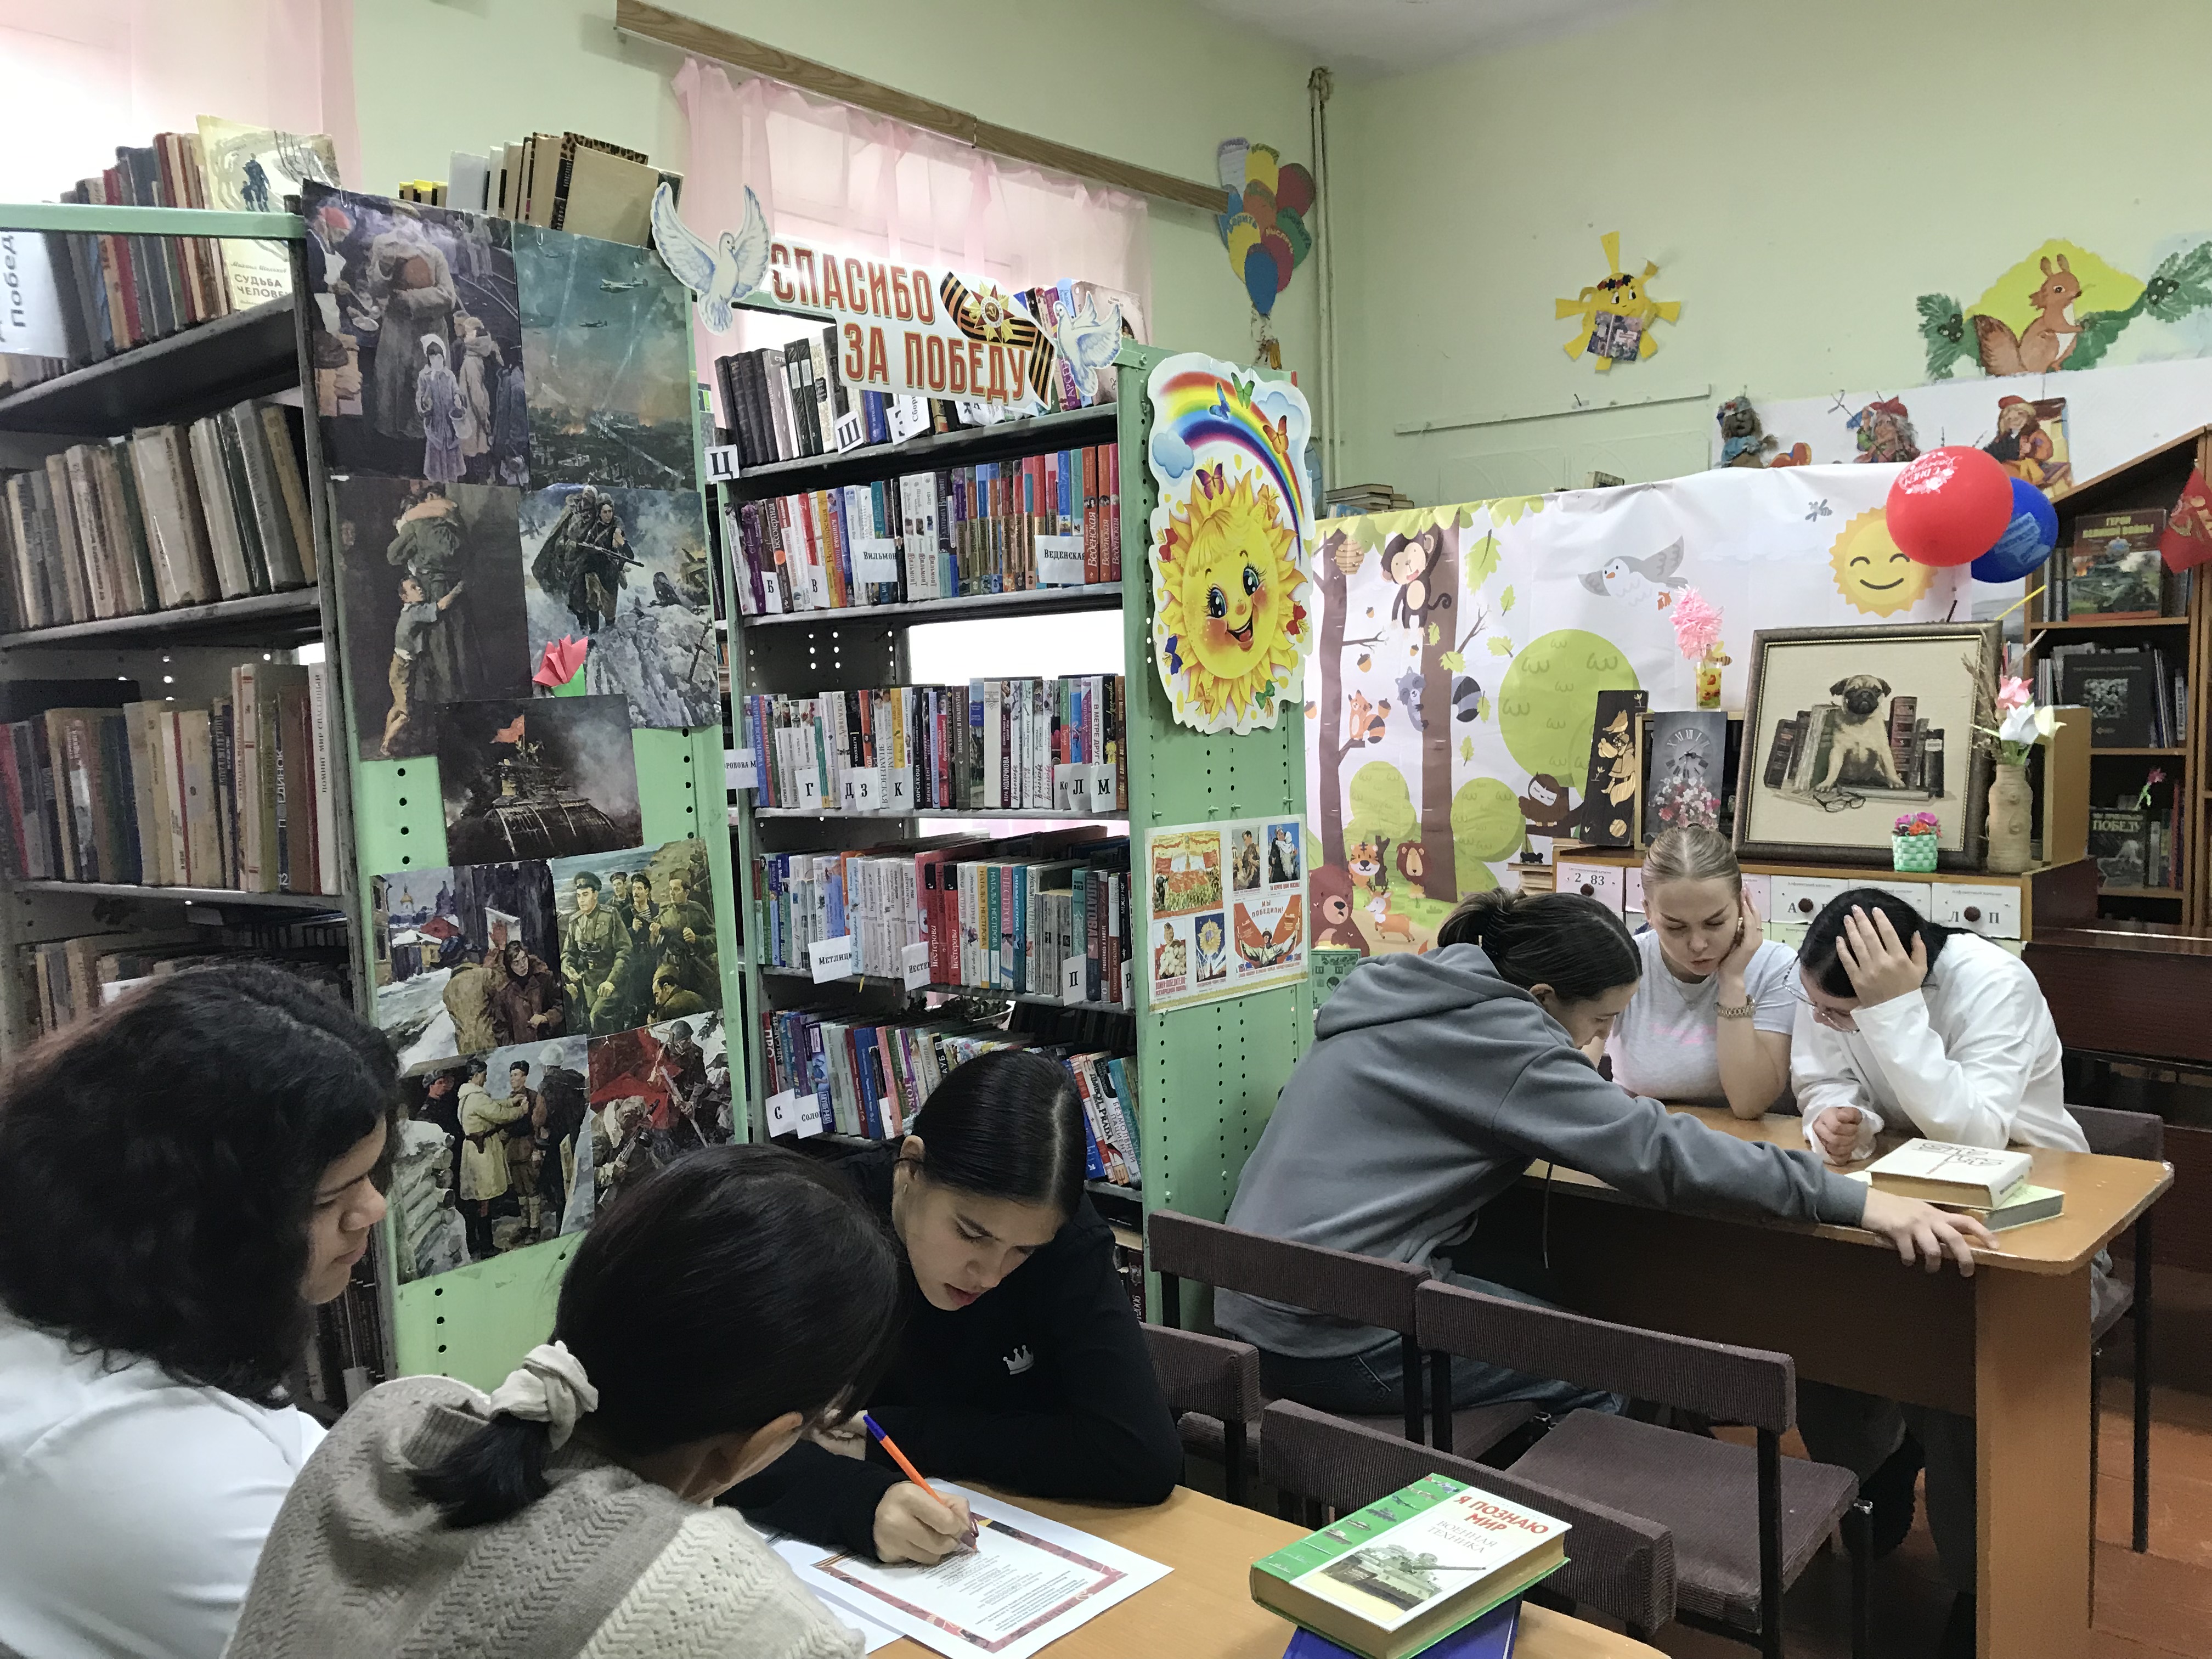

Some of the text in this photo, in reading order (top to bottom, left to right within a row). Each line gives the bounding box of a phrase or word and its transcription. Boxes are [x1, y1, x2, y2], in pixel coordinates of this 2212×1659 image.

[234, 274, 283, 288] СУДЬБА
[770, 242, 935, 325] СПАСИБО
[844, 323, 1025, 405] ЗА ПОБЕДУ
[837, 417, 861, 450] Ш
[709, 451, 733, 479] Ц
[769, 503, 780, 548] Бессмертная
[1087, 512, 1097, 567] Веденская
[1101, 519, 1110, 566] Веденская
[1111, 517, 1120, 565] Веденская
[767, 579, 774, 593] Б
[812, 579, 818, 592] В
[319, 757, 327, 793] ПОМНИТ
[725, 760, 757, 769] РОНОВА М
[878, 743, 888, 804] ЗНАМЕНСКАЯ
[276, 748, 286, 828] ПОЕДИНОК
[805, 782, 814, 797] Г
[845, 782, 854, 799] Д
[860, 782, 868, 797] З
[894, 781, 903, 797] К
[1073, 780, 1084, 795] Л
[1098, 778, 1110, 795] М
[1575, 873, 1605, 886] 2 83
[1087, 876, 1098, 936] ПЛАТОВА
[1251, 906, 1284, 918] ПОБЕДИЛИ!
[1787, 902, 1797, 913] А
[1948, 911, 1959, 922] Л
[1989, 912, 2000, 924] П
[1069, 970, 1079, 988] П
[1125, 973, 1132, 989] Р
[1089, 1074, 1104, 1105] ДЬЯВОЛ
[774, 1105, 783, 1120] С
[1098, 1108, 1114, 1141] PRADA
[1110, 1114, 1127, 1155] ПАЦИЕНТ
[1113, 1102, 1136, 1163] БЕЗМОЛВНЫЙ
[1453, 1496, 1473, 1504] Я
[1468, 1501, 1549, 1534] ПОЗНАЮ
[1464, 1513, 1508, 1531] МИР
[1427, 1526, 1485, 1553] ТЕХНИКА
[1436, 1521, 1498, 1548] ВОЕННАЯ
